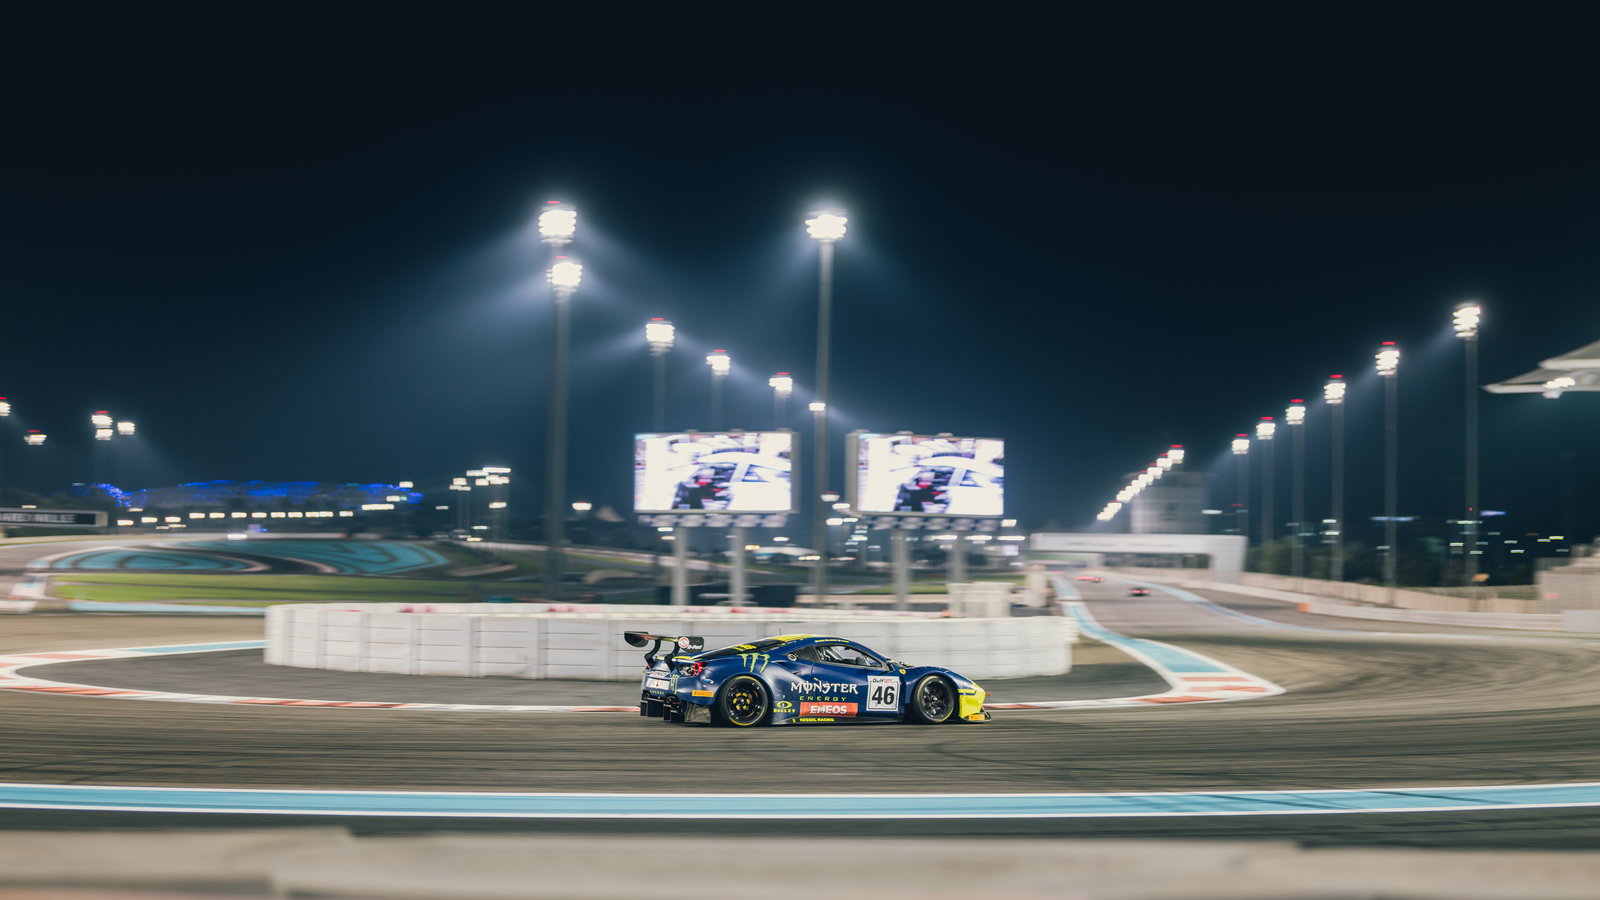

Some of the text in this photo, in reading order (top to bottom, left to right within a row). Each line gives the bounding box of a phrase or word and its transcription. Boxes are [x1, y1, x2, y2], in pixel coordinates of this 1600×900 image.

[791, 681, 858, 694] MONSTER
[872, 686, 895, 704] 46
[810, 706, 847, 714] ENEOS
